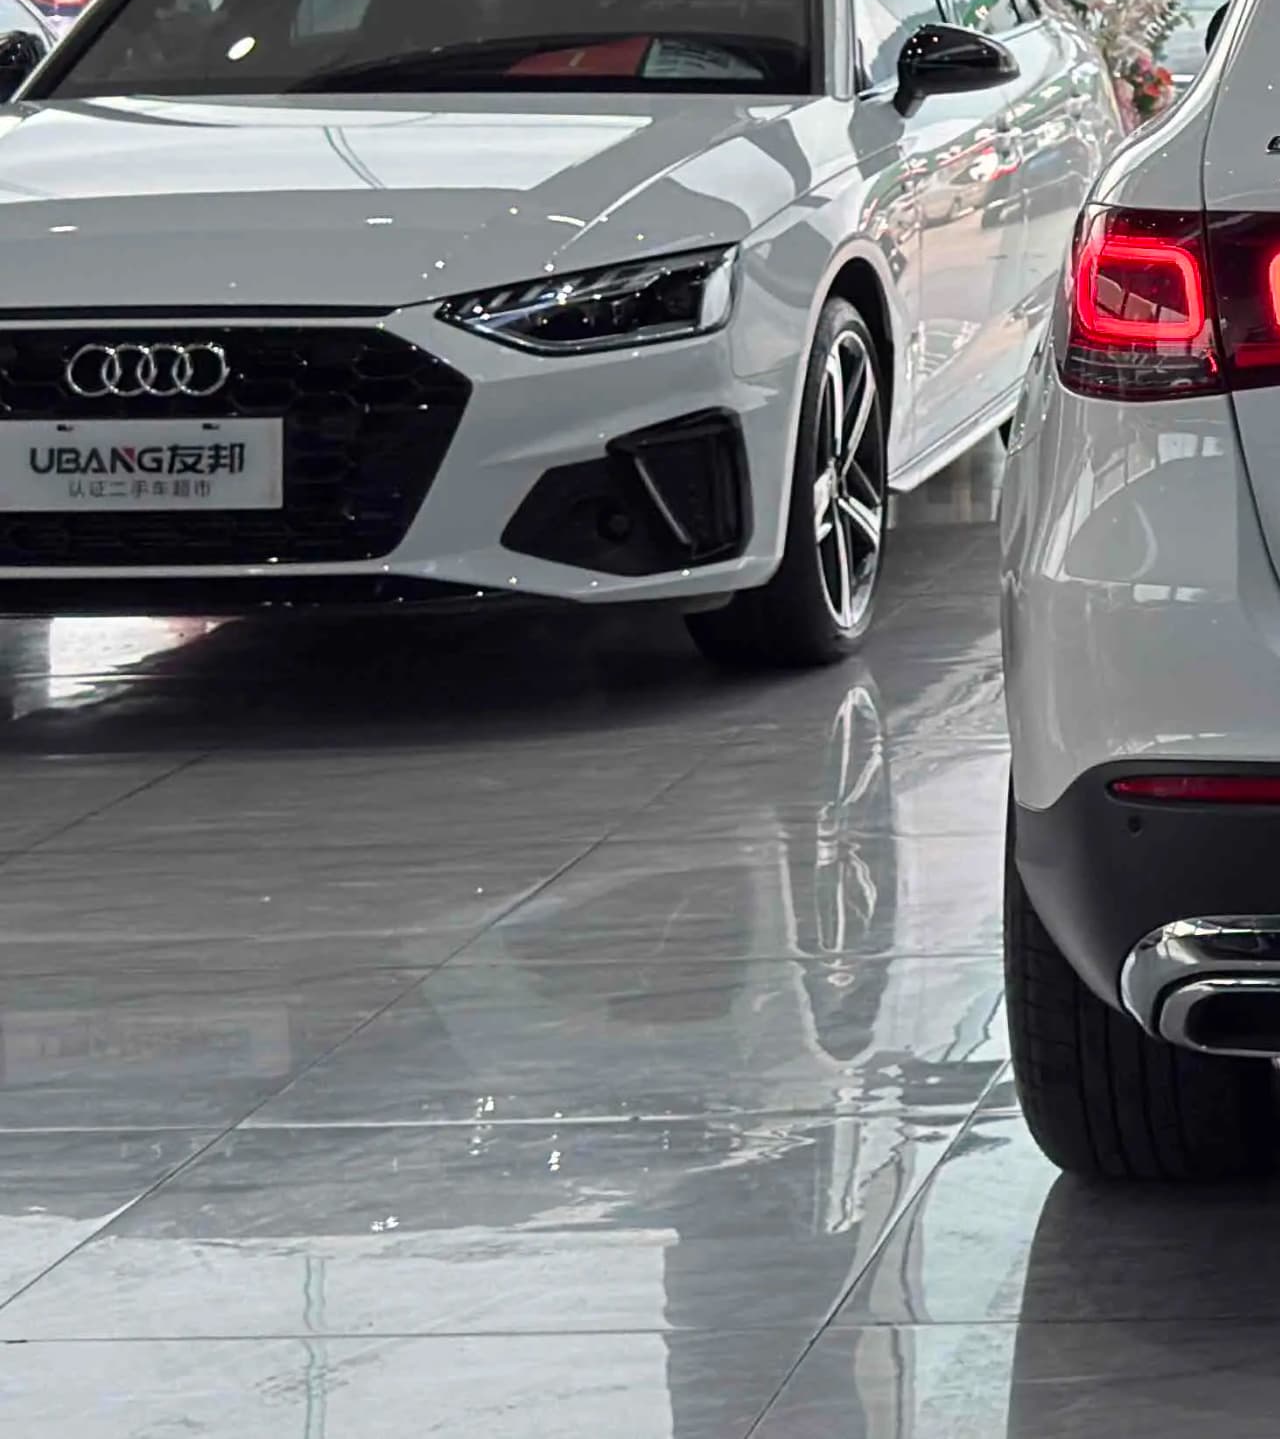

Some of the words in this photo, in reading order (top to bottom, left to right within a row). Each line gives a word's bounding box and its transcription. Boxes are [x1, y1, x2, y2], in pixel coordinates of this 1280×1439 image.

[68, 479, 211, 499] 认证二手车超市
